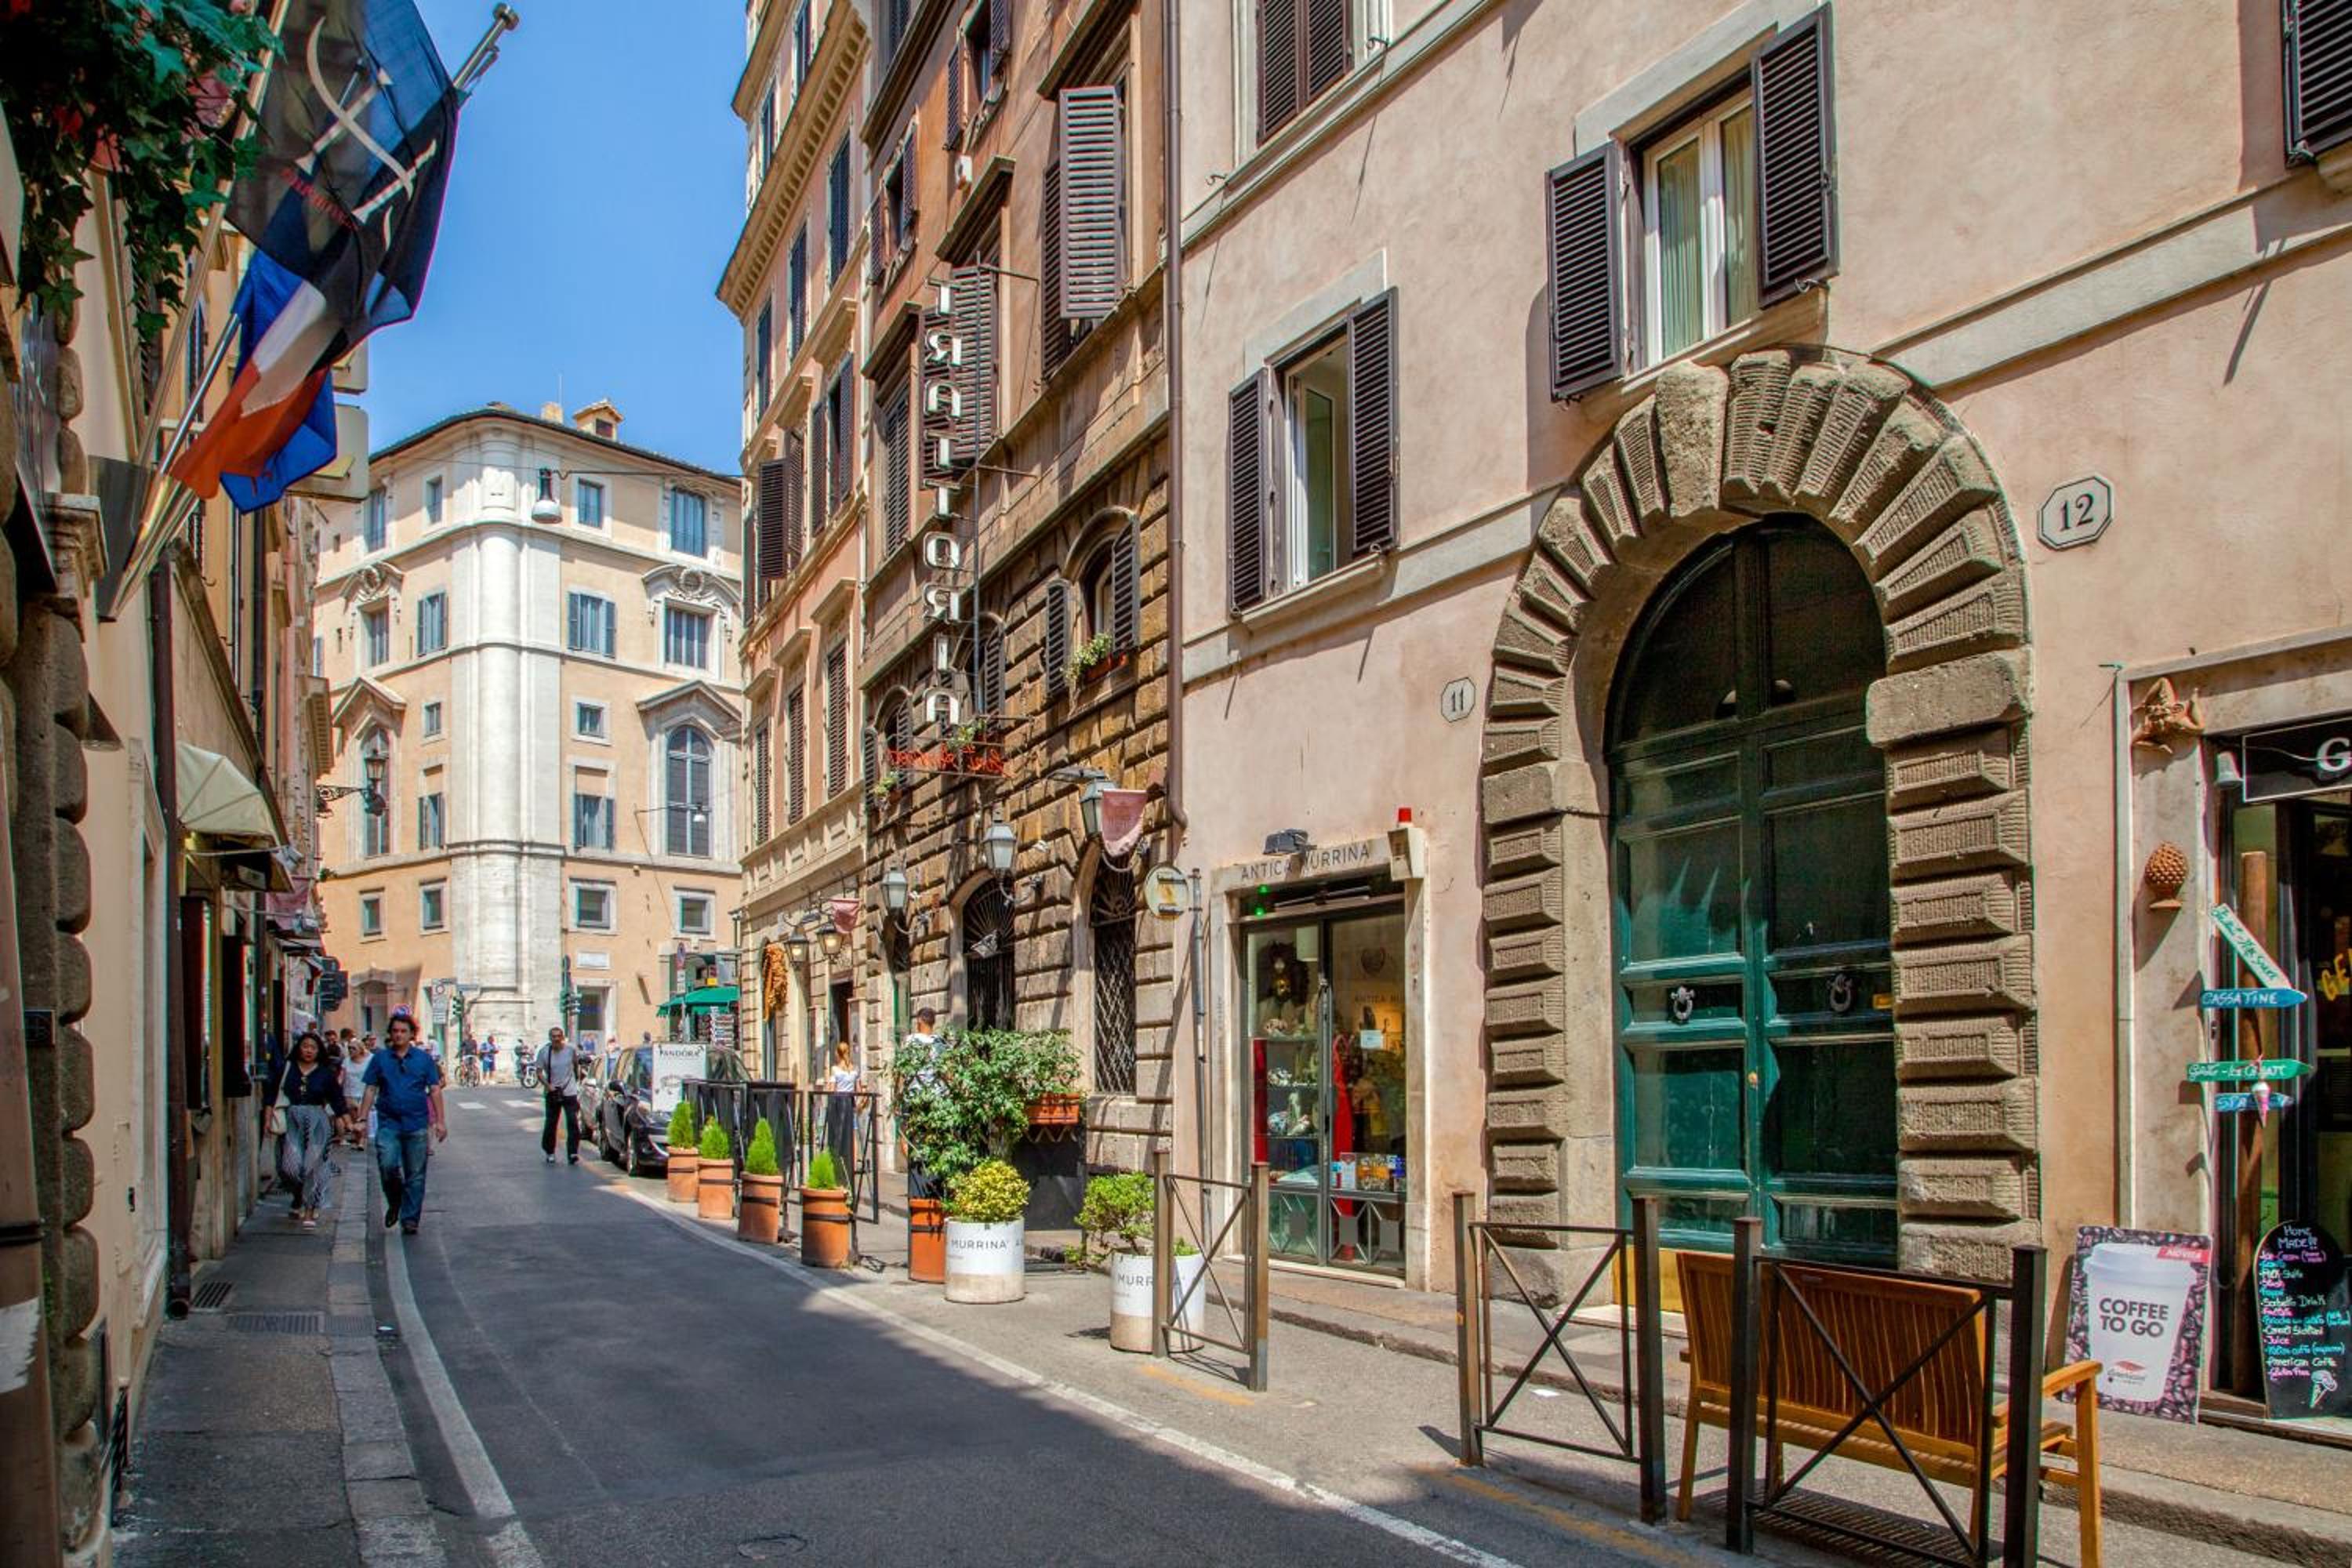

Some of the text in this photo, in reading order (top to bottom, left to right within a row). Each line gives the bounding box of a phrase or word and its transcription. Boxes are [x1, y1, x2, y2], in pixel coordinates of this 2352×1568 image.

[2060, 493, 2094, 532] 12
[1451, 687, 1464, 712] 11
[1241, 859, 1293, 880] ANTICA
[2201, 990, 2278, 1004] CASSATINE
[2100, 1298, 2169, 1320] COFFEE
[2100, 1315, 2164, 1338] TO GO
